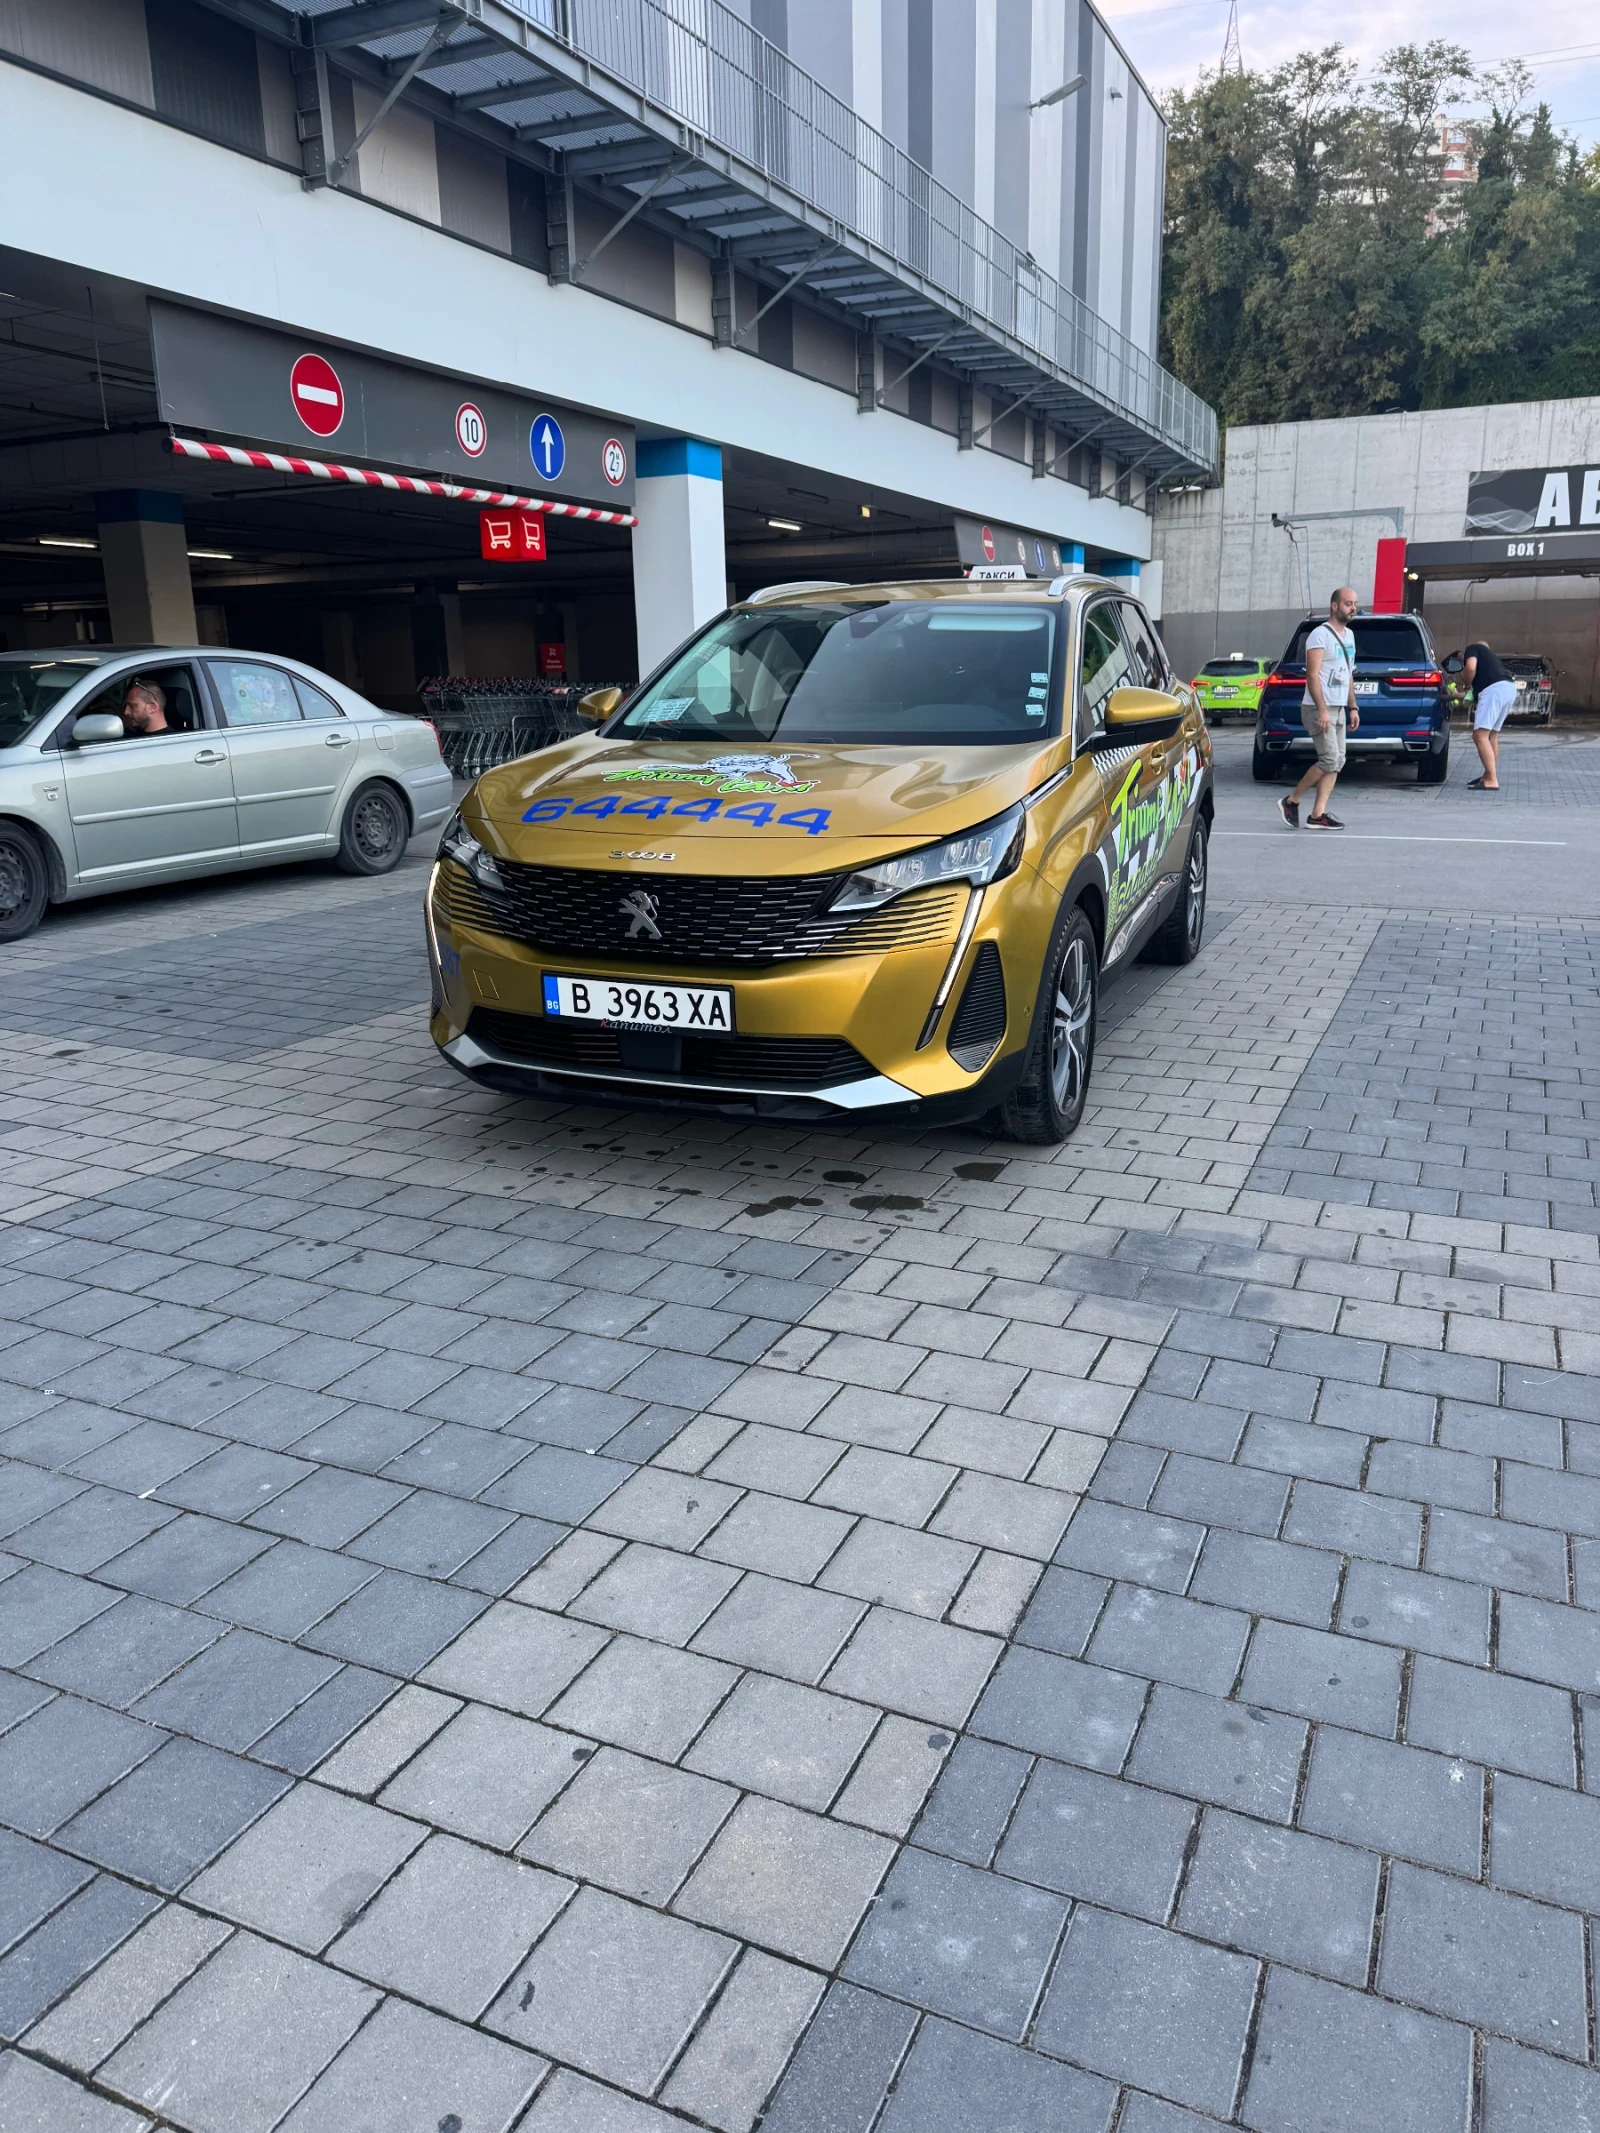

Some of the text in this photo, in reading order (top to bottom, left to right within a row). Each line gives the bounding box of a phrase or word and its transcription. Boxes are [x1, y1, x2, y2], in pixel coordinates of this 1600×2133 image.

[465, 418, 479, 443] 10
[1507, 542, 1544, 557] BOX 1
[979, 571, 1015, 579] ТАКСИ
[521, 795, 833, 836] 644444
[608, 850, 676, 861] 3008
[547, 1000, 559, 1010] BG
[572, 983, 727, 1027] B 3963 XA
